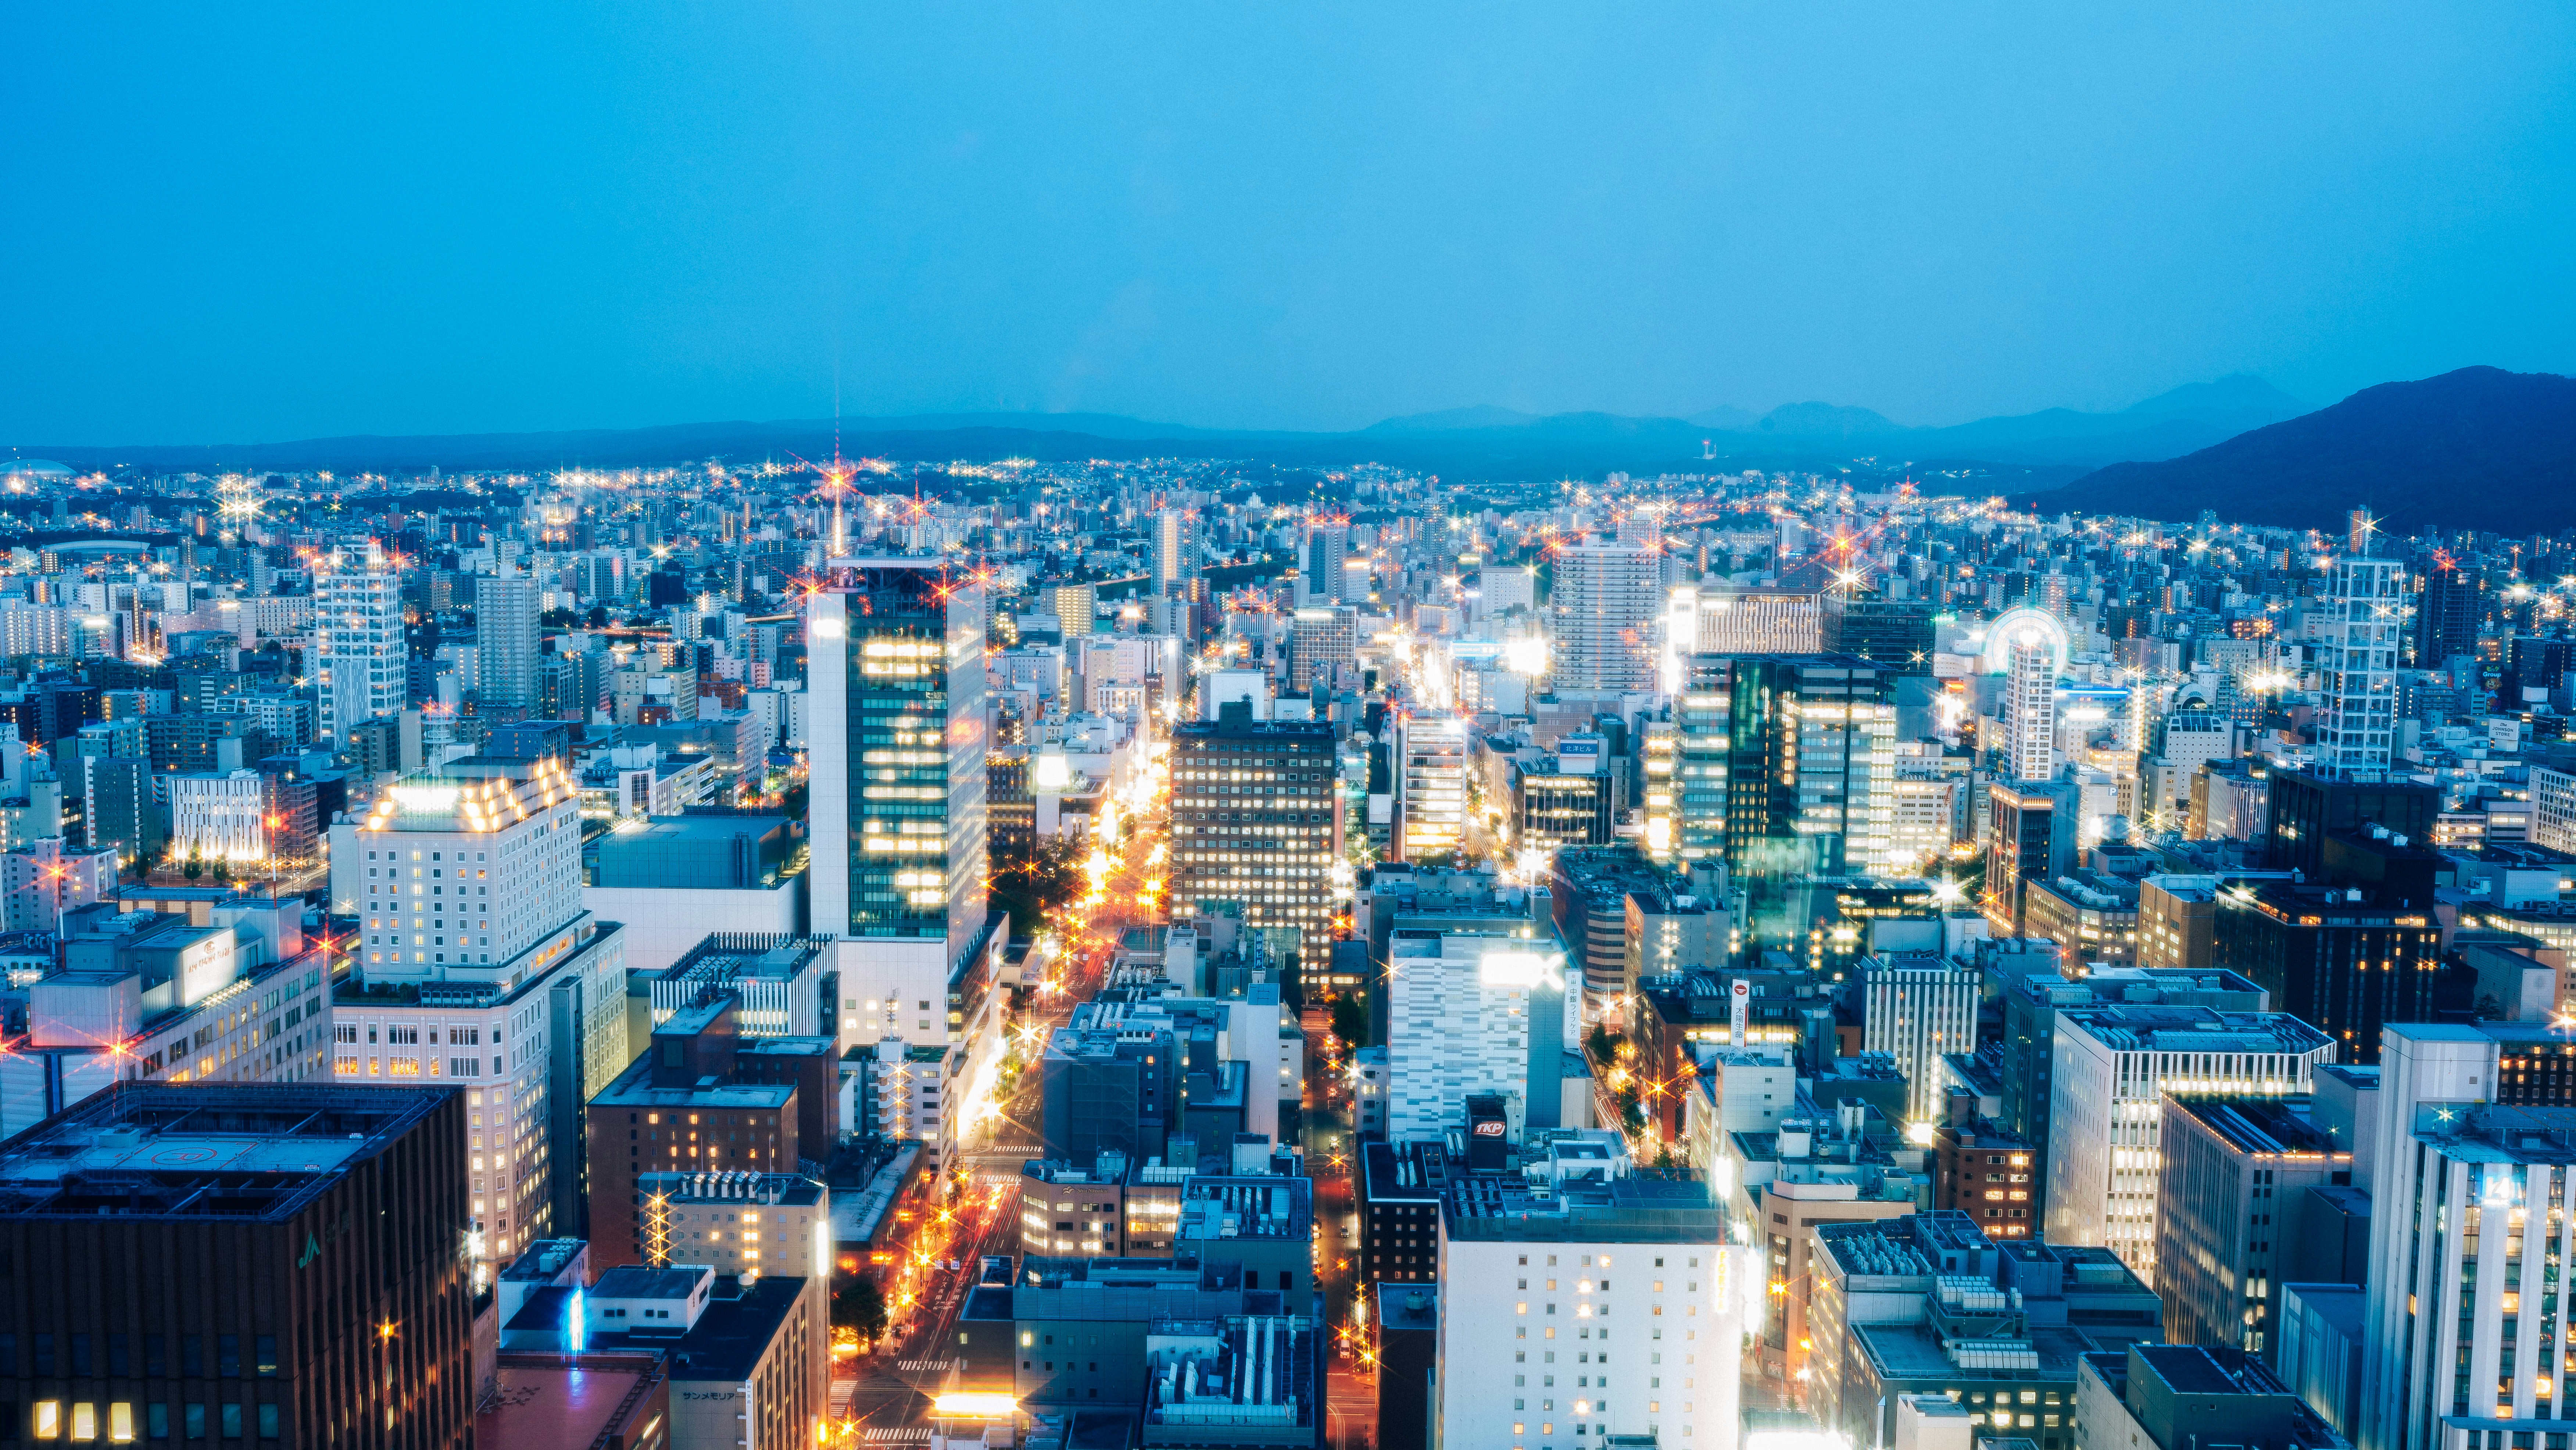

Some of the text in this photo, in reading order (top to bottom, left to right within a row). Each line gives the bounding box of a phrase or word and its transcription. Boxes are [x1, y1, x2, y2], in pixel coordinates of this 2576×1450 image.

[2110, 788, 2117, 796] P
[1735, 1007, 1744, 1039] 太陽生命
[1477, 1123, 1502, 1133] TKP
